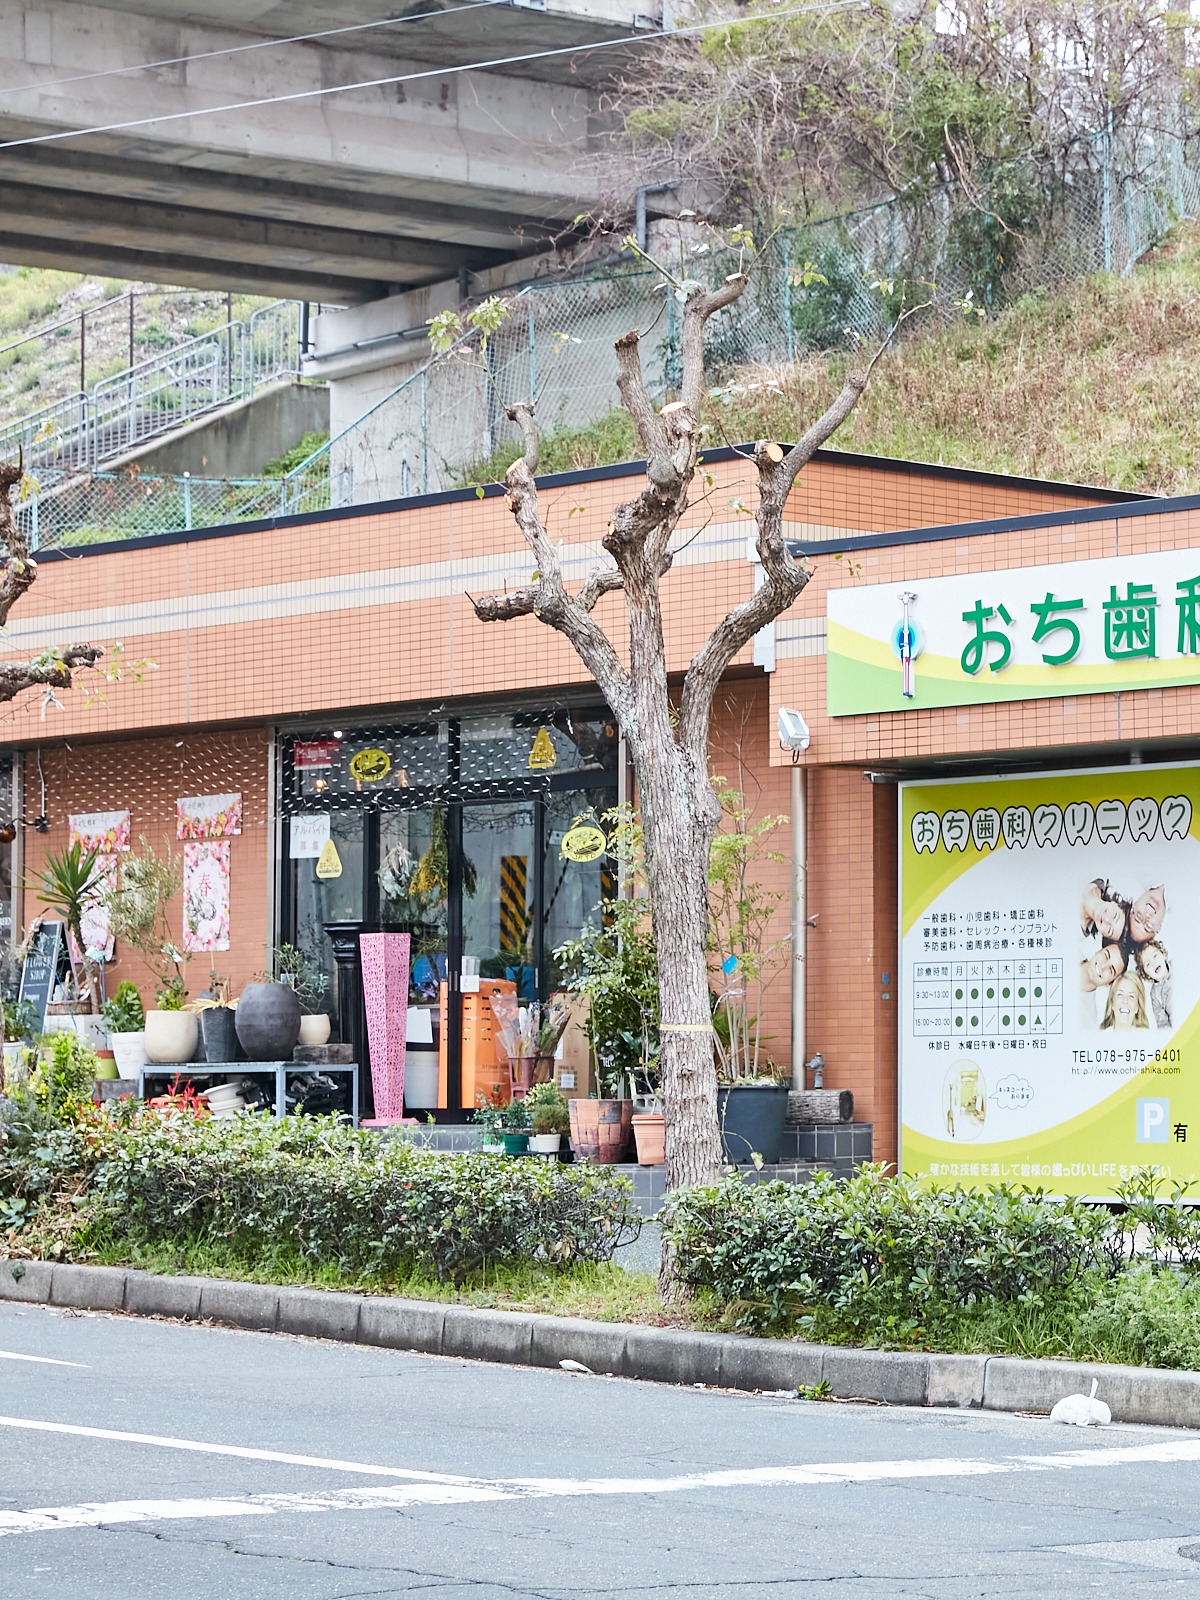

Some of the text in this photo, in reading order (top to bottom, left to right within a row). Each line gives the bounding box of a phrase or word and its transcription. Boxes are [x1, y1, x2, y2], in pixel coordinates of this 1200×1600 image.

[916, 802, 1187, 843] おち歯科クリニック
[923, 909, 1044, 923] 一般歯科・小児歯科・矯正歯科
[923, 923, 1058, 938] 審美歯科・セレック・インプラント
[923, 937, 1053, 952] 予防歯科・歯周病治療・各種検診
[916, 963, 1058, 977] 診療時間 月 火 水 木 金 土 日
[928, 1041, 950, 1050] 休診日
[1071, 1065, 1181, 1075] htp://www.ochi-shika.com
[1143, 1102, 1188, 1142] P 有
[930, 1162, 1172, 1178] 確かな技術を通して皆様の歯っぴいLIFEをおい
